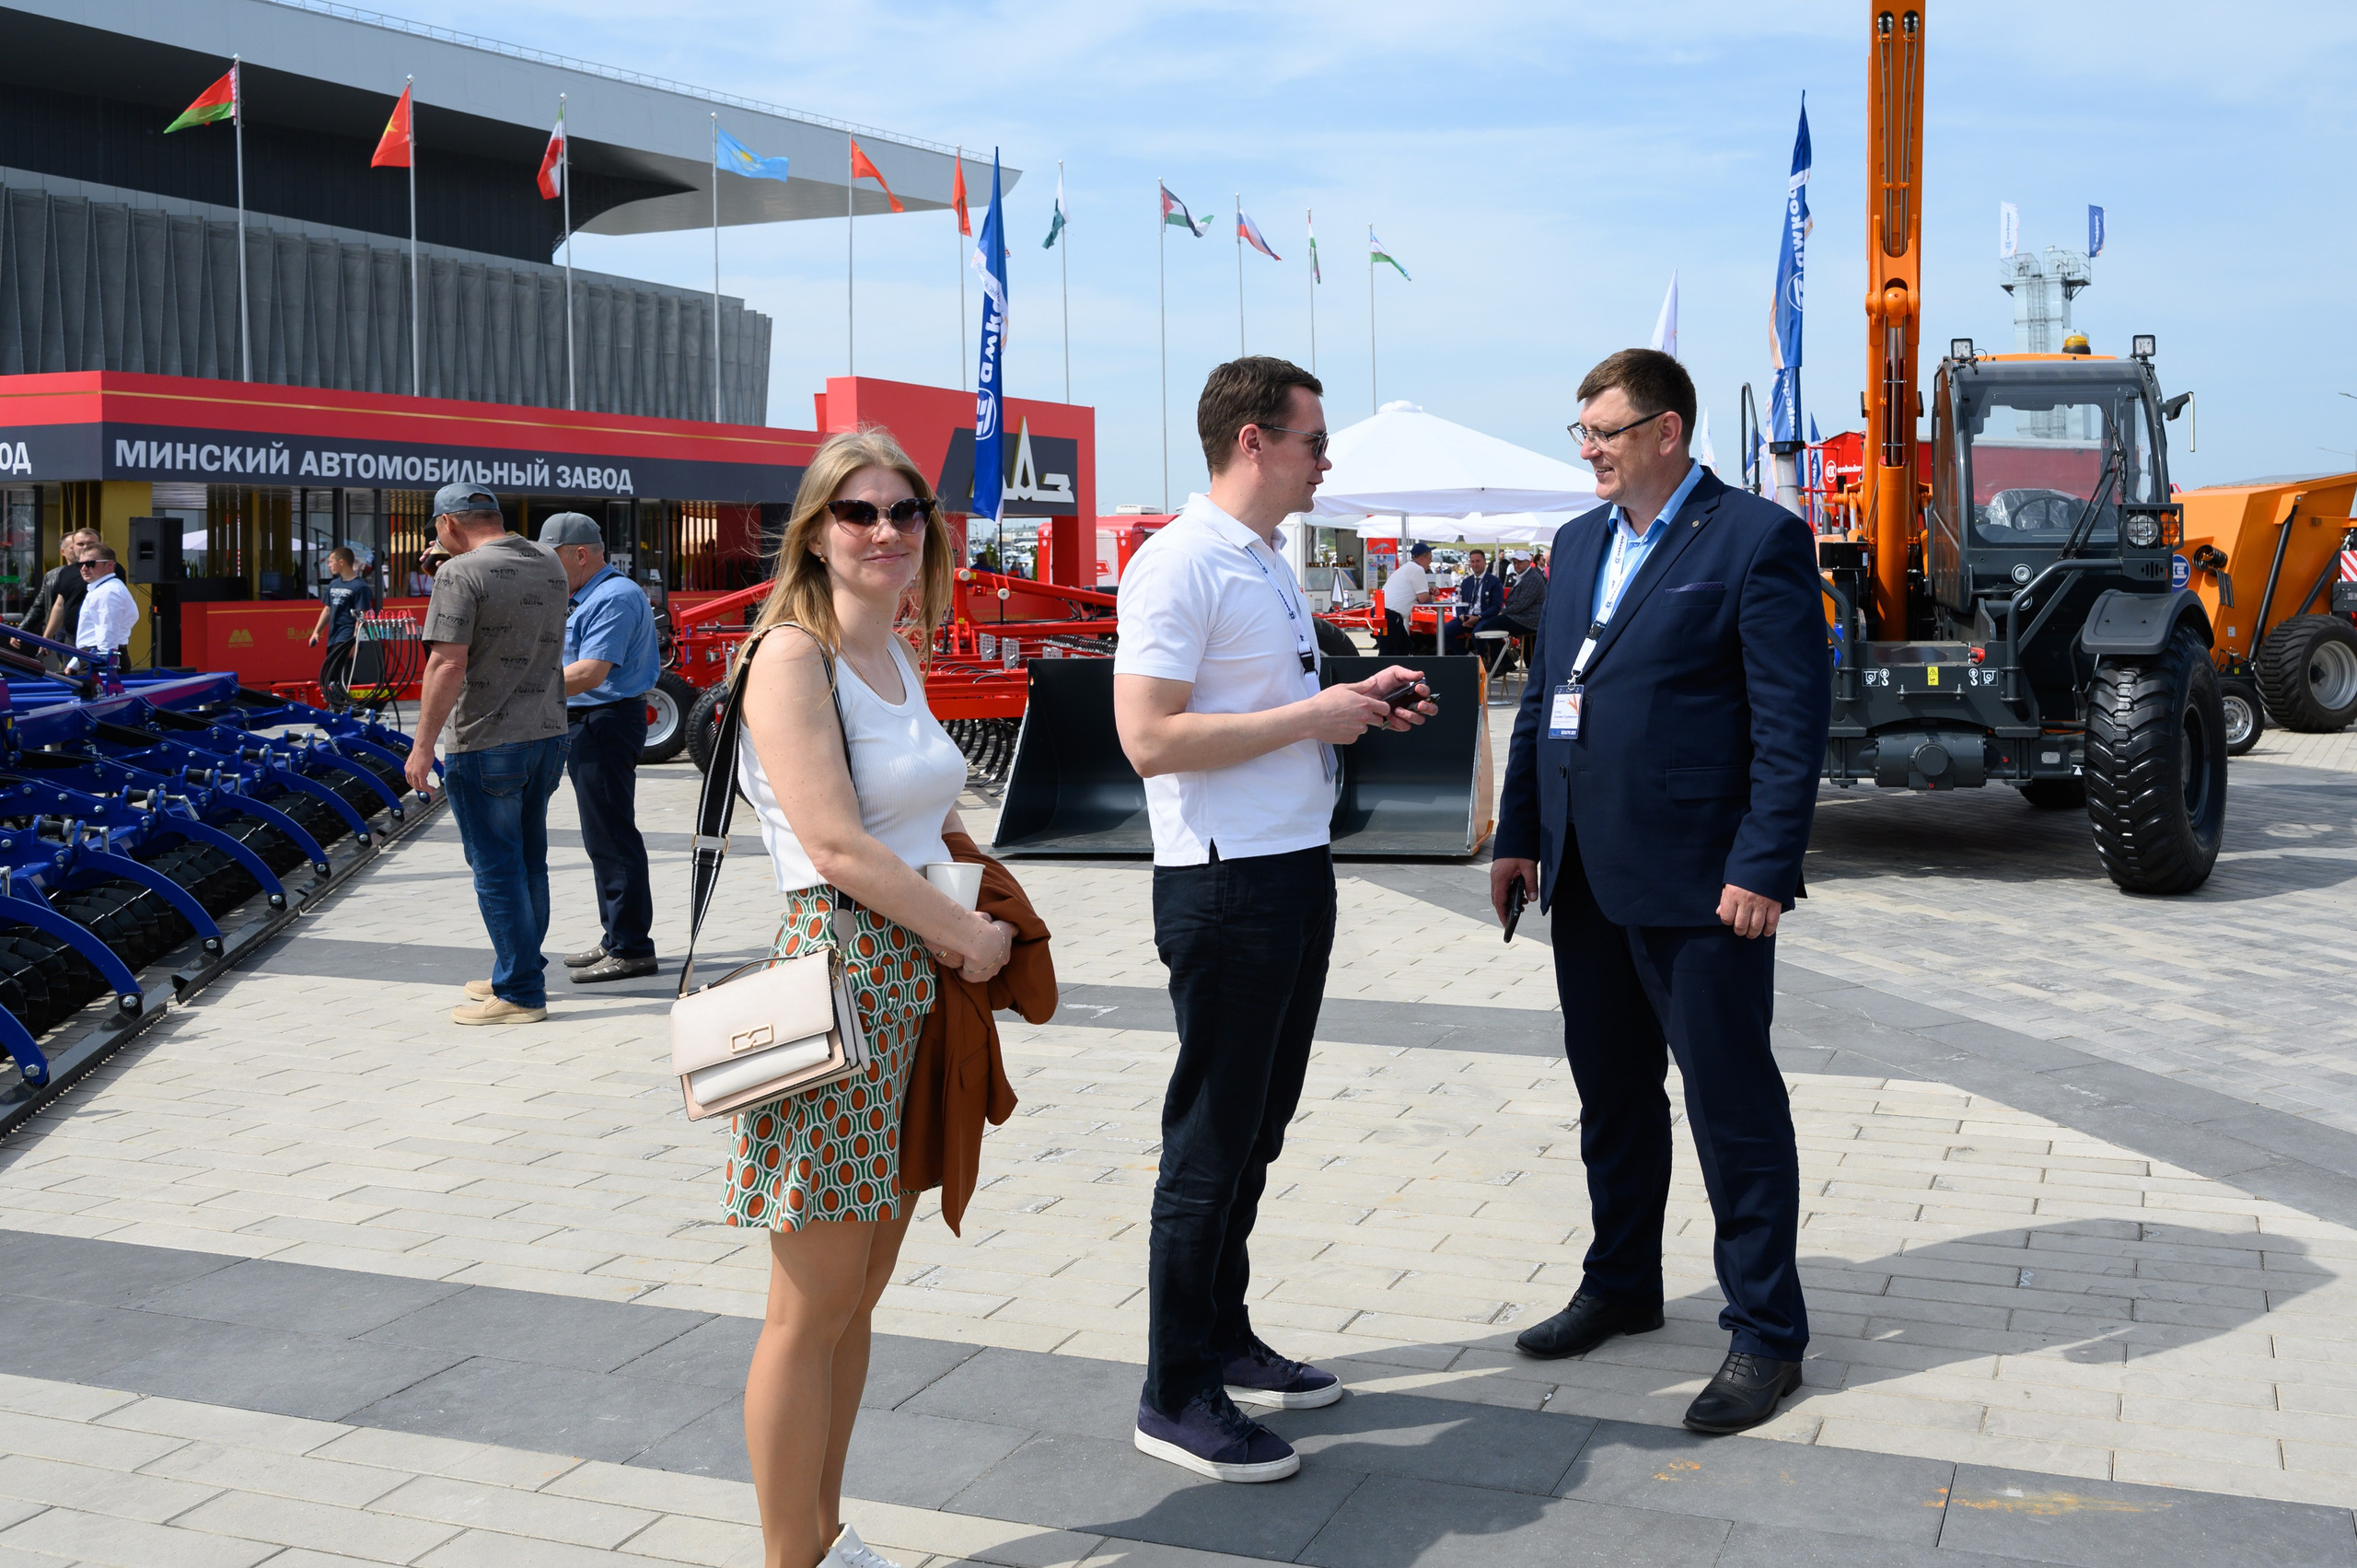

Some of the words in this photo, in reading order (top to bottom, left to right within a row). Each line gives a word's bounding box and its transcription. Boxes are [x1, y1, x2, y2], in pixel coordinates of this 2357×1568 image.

[115, 438, 290, 475] МИНСКИЙ
[298, 449, 551, 487] АВТОМОБИЛЬНЫЙ
[556, 464, 634, 495] ЗАВОД
[969, 414, 1075, 504] АЗ
